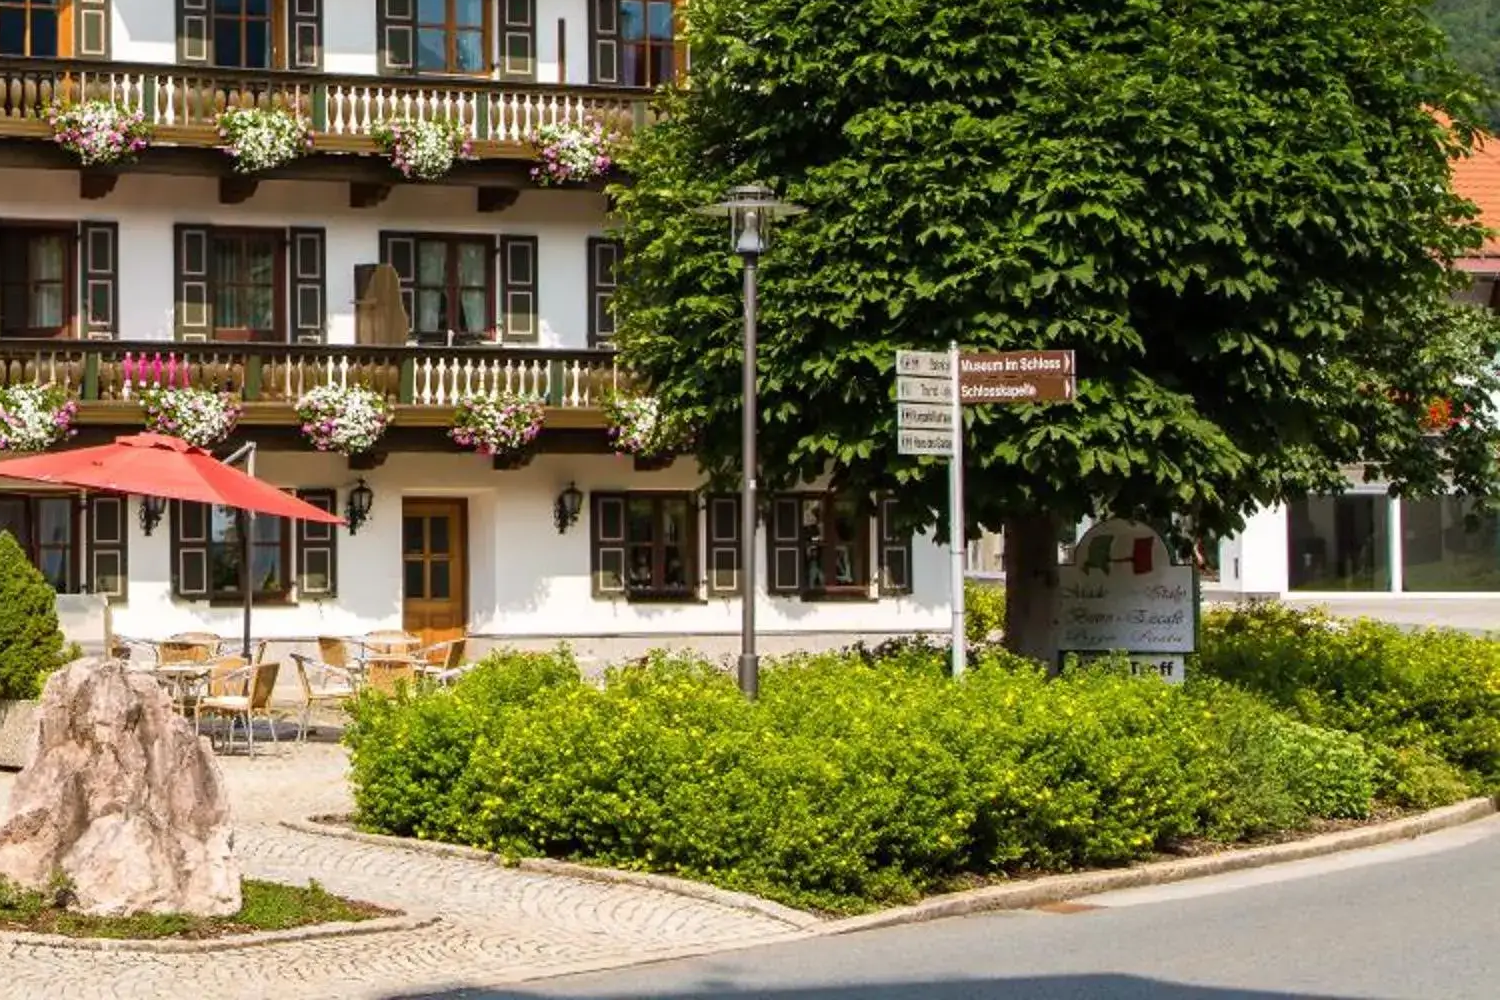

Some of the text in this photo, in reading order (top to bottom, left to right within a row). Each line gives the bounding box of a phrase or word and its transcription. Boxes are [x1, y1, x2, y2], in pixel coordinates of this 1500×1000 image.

[961, 358, 1003, 372] Museum
[1005, 357, 1019, 371] im
[1020, 356, 1060, 371] Schloss
[961, 382, 1037, 399] Schlosskapelle
